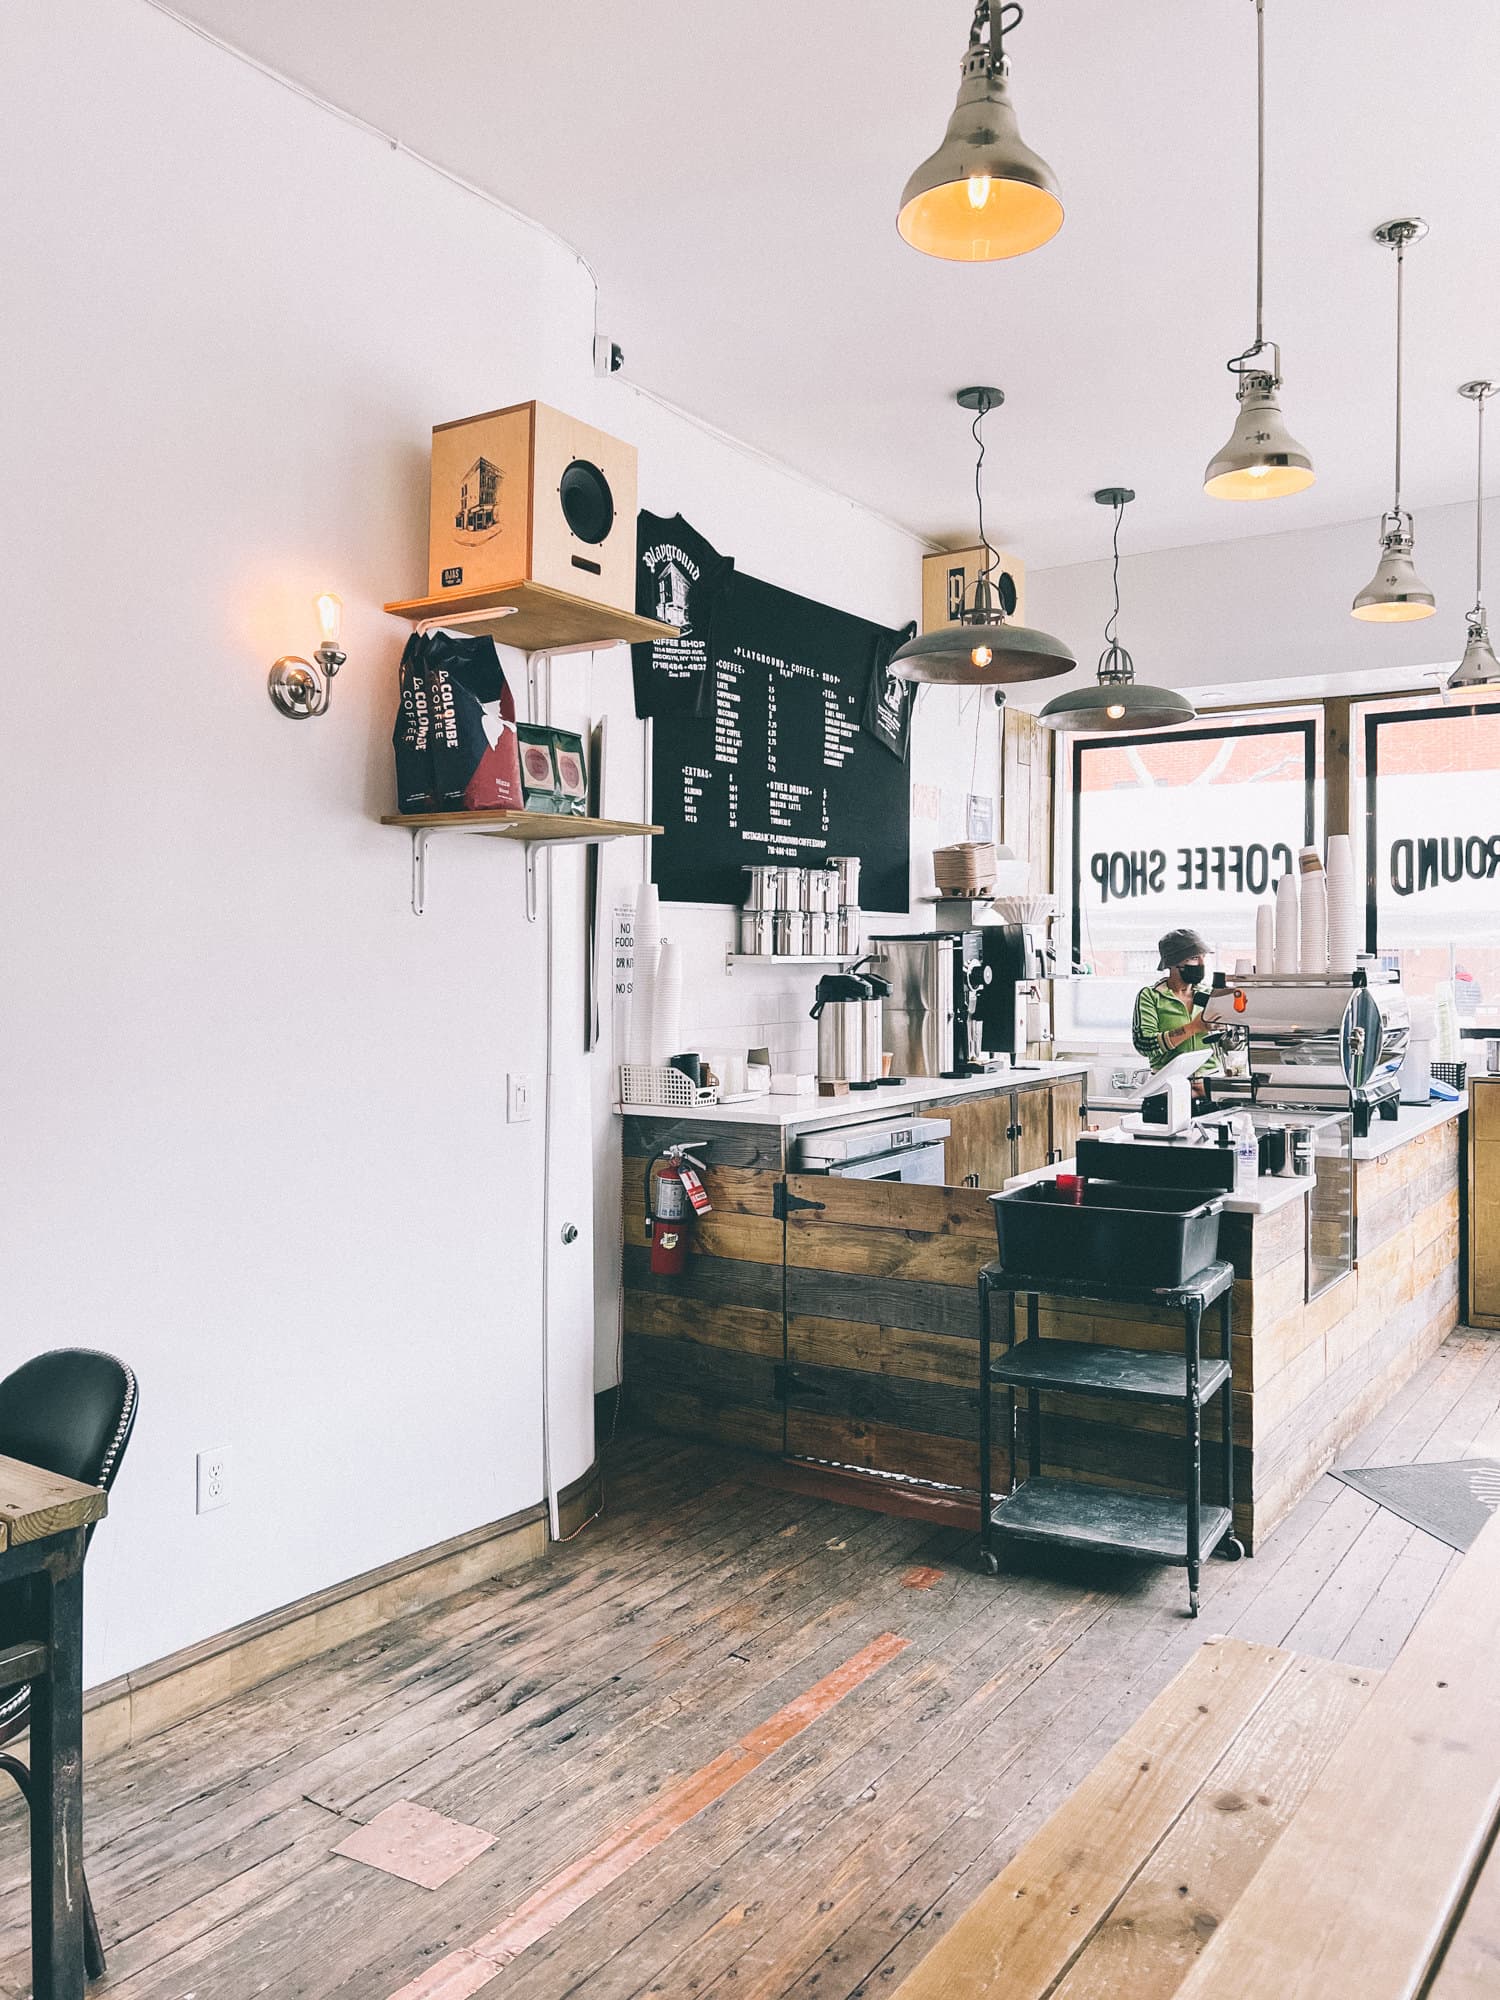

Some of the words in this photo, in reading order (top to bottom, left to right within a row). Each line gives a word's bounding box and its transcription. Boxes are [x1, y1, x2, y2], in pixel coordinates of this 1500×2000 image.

[642, 544, 700, 581] Playground
[681, 640, 705, 648] SHOP
[718, 660, 742, 673] COFFEE
[737, 646, 784, 669] PLAYGROUND
[791, 664, 814, 677] COFFEE
[822, 672, 838, 684] SHOP
[439, 671, 449, 683] La
[413, 677, 423, 691] La
[403, 691, 417, 742] COFFEE
[432, 685, 444, 739] COFFEE
[440, 684, 458, 748] COLOMBE
[685, 766, 709, 779] EXTRAS
[770, 781, 788, 792] OTHER
[620, 923, 631, 934] NO
[615, 937, 634, 947] FOOD
[615, 983, 626, 994] NO
